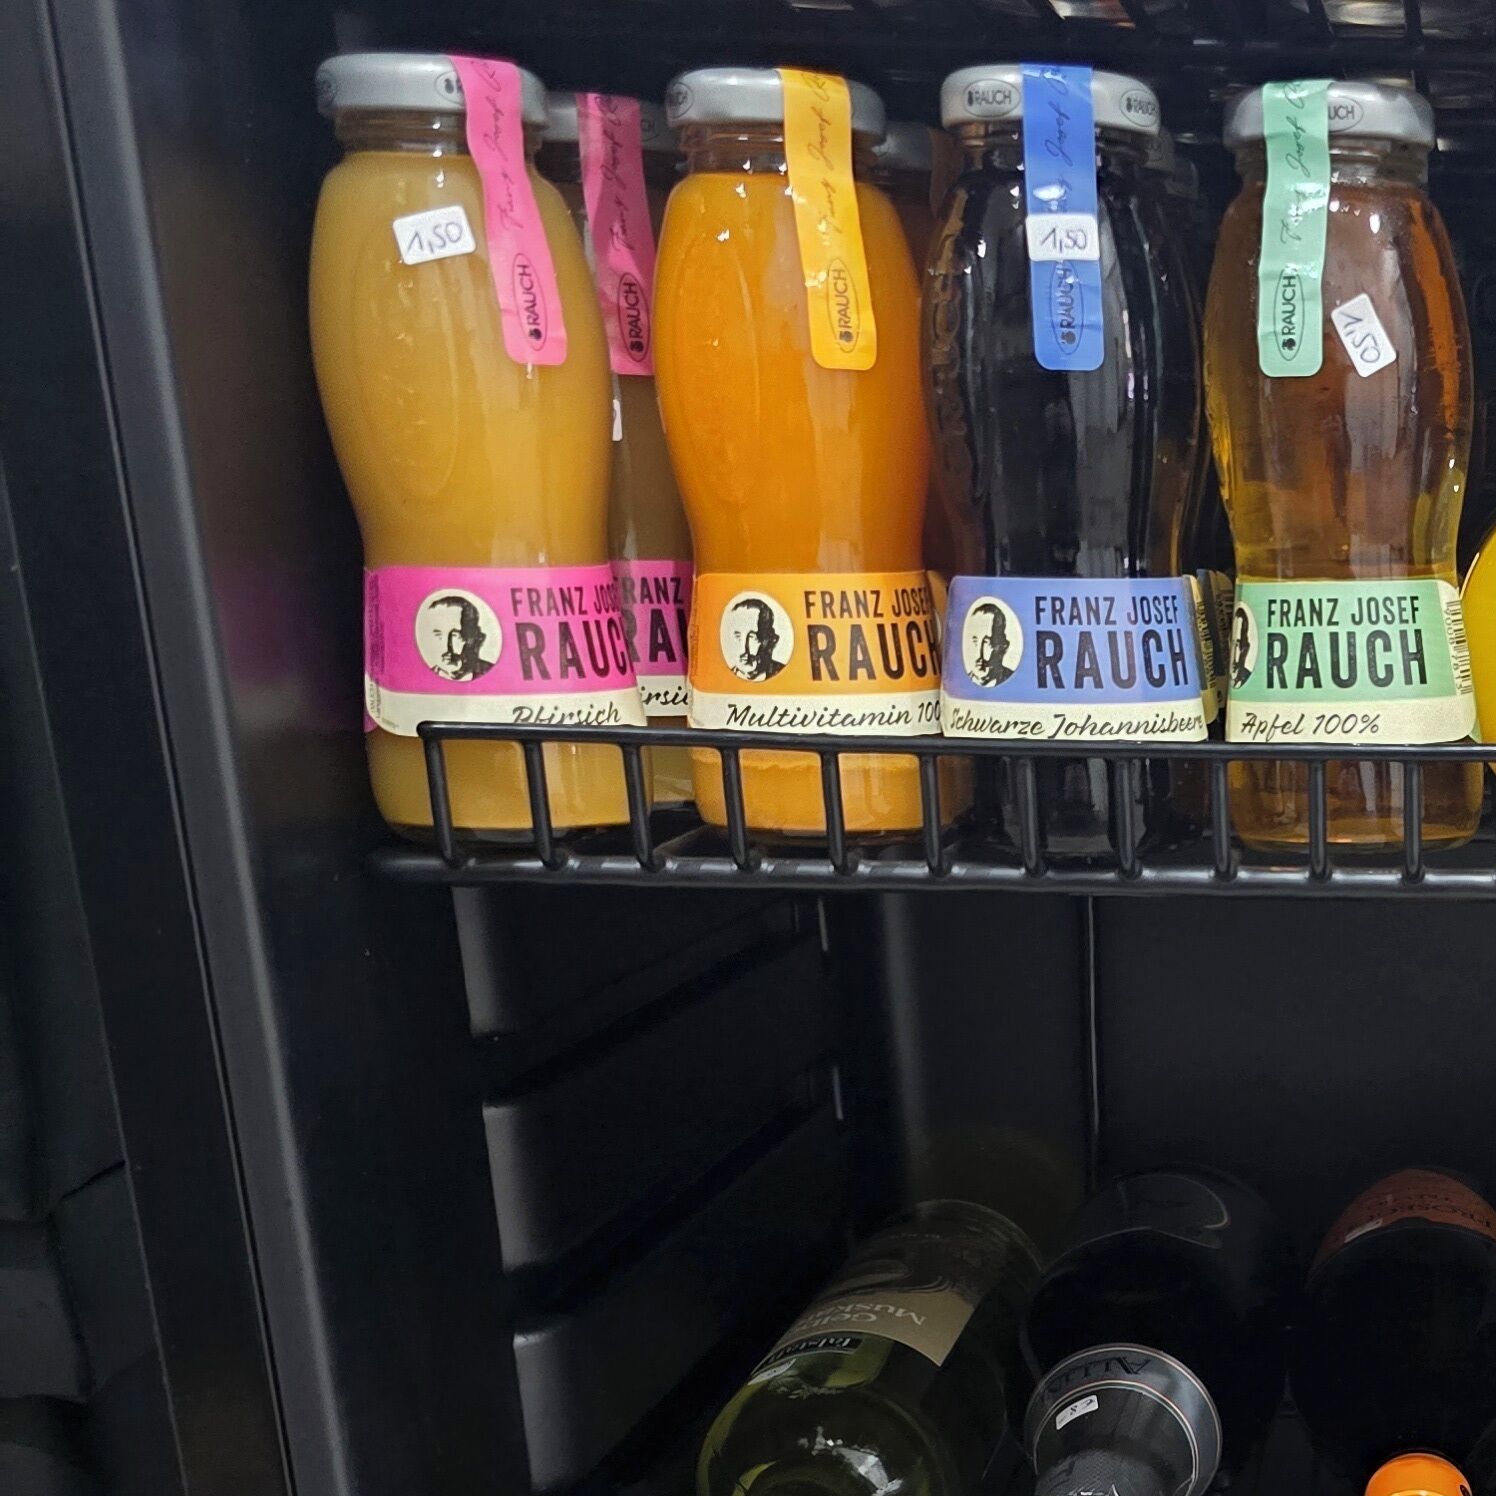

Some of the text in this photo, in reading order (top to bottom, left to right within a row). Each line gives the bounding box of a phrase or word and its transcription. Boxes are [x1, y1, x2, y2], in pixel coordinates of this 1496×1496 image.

[973, 88, 1012, 106] RAUCH
[406, 220, 464, 258] 1,50
[1040, 227, 1088, 254] 1,50
[516, 262, 543, 327] RAUCH
[836, 267, 854, 332] RAUCH
[1280, 274, 1297, 336] RAUCH
[622, 281, 646, 343] RAUCH
[1341, 311, 1382, 365] 1,50
[510, 586, 588, 617] FRANZ
[804, 588, 885, 619] FRANZ
[1035, 594, 1179, 627] FRANZ JOSEF
[1267, 595, 1420, 628] FRANZ JOSEF
[1036, 627, 1189, 690] RAUCH
[1266, 629, 1428, 690] RAUCH
[725, 702, 913, 730] Multivitamin
[949, 707, 1047, 737] Schwarze
[1240, 712, 1381, 743] Apfel 100%
